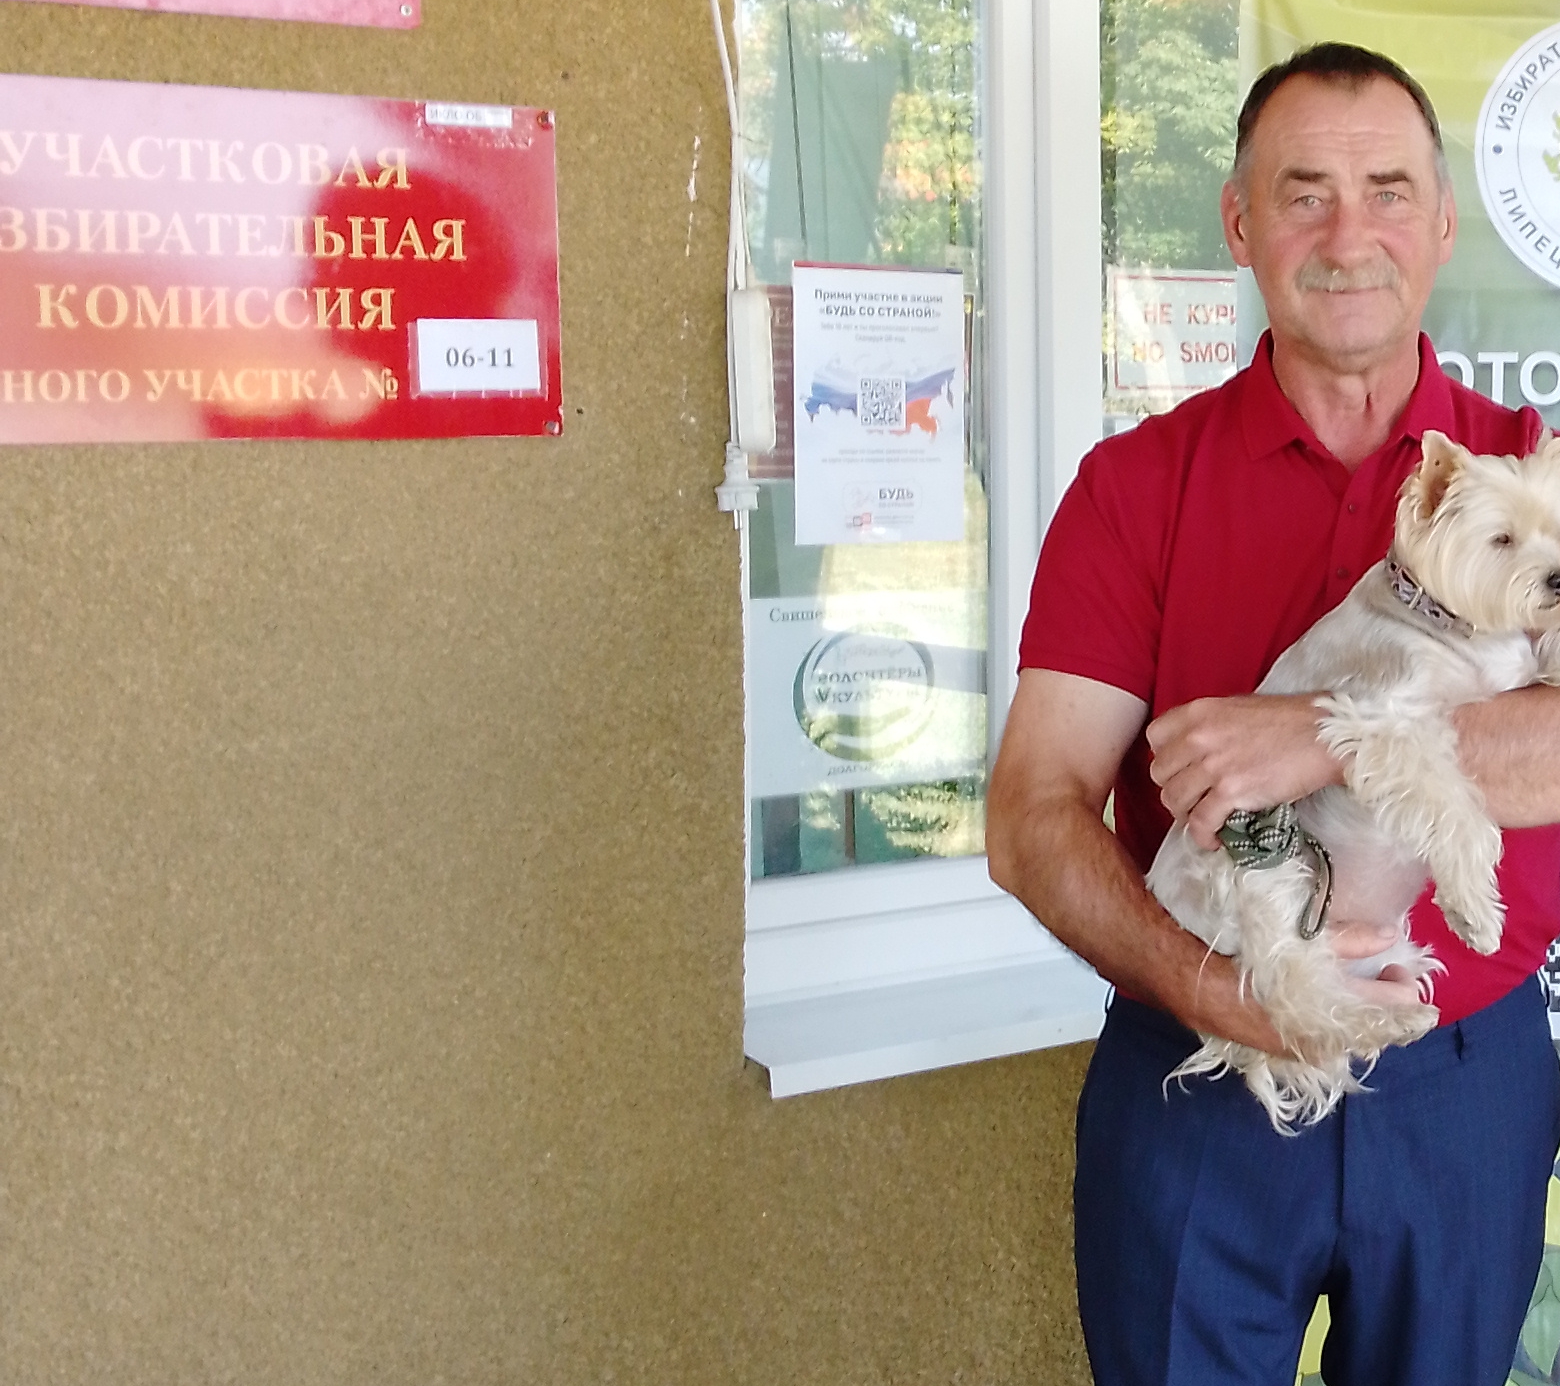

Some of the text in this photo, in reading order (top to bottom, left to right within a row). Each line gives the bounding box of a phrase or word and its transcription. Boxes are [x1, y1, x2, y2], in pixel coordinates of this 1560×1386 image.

[0, 131, 411, 190] УЧАСТКОВАЯ
[0, 207, 468, 261] ЗБИРАТЕЛЬНАЯ
[814, 288, 851, 301] Прими
[852, 291, 898, 303] участие
[911, 295, 943, 304] акции
[35, 283, 396, 332] КОМИССИЯ
[859, 306, 875, 317] СО
[1144, 303, 1172, 324] НЕ
[445, 347, 516, 369] 06-11
[1132, 341, 1164, 363] NO
[2, 367, 399, 403] НОГО УЧАСТКА №
[878, 488, 914, 501] БУДЬ
